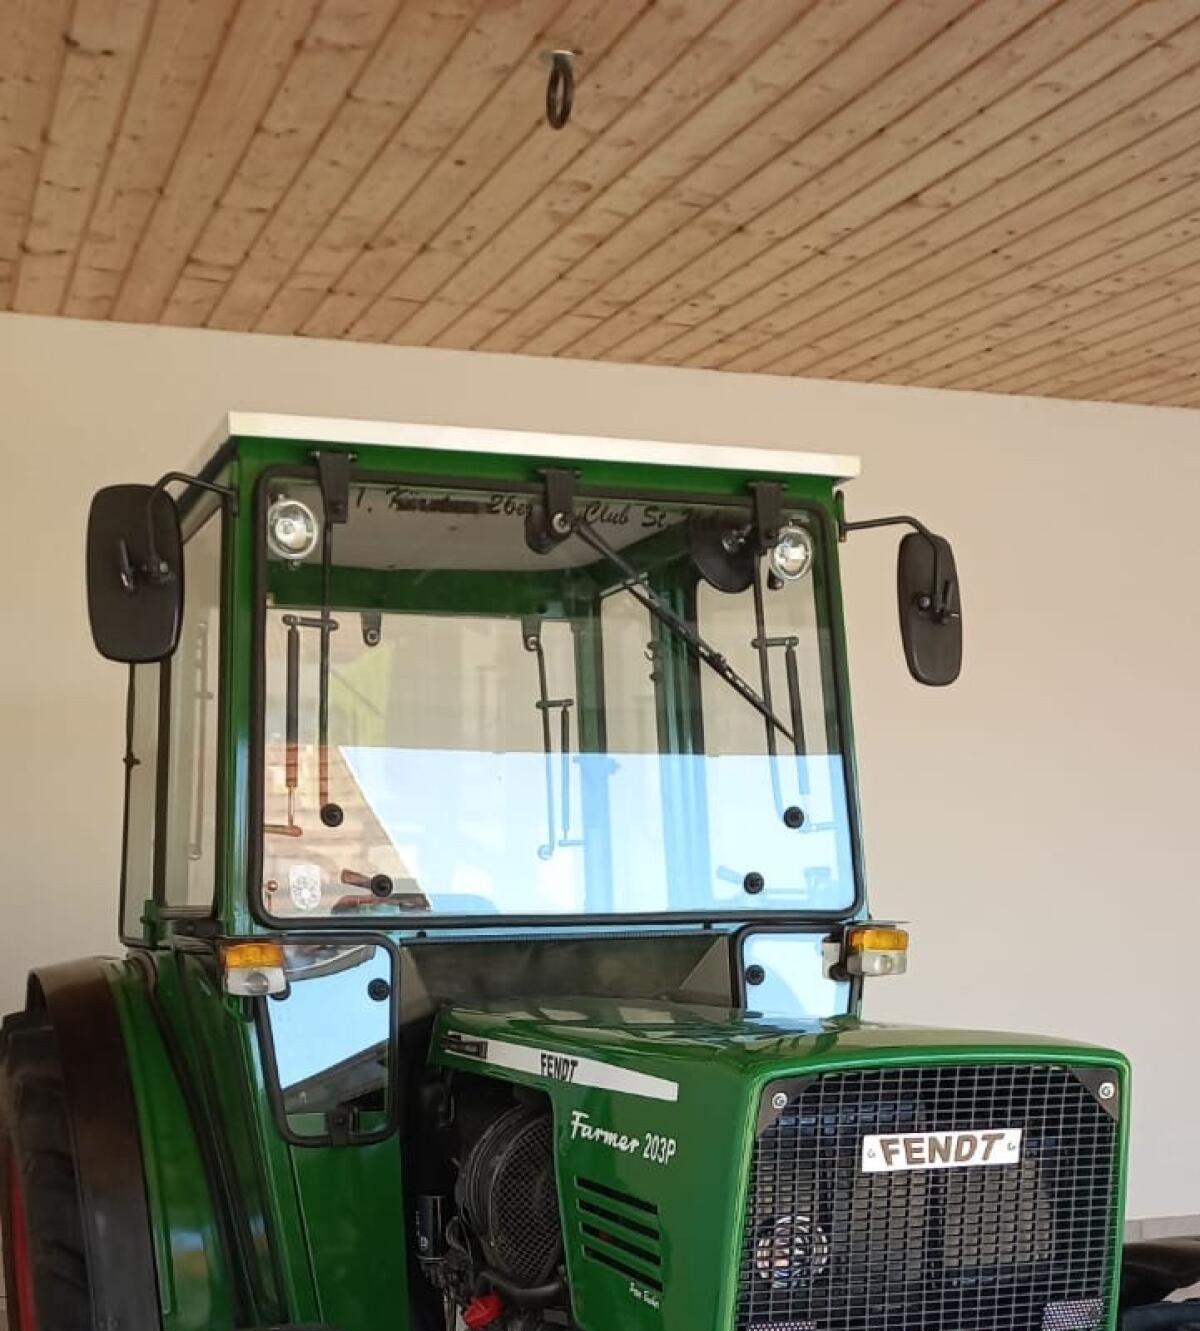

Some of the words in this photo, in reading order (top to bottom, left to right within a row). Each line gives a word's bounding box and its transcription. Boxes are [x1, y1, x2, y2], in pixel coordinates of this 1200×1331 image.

[585, 501, 629, 525] Club
[540, 1053, 579, 1083] FENDT
[570, 1110, 640, 1154] Farmer
[643, 1132, 677, 1165] 203P
[880, 1133, 1006, 1167] FENDT
